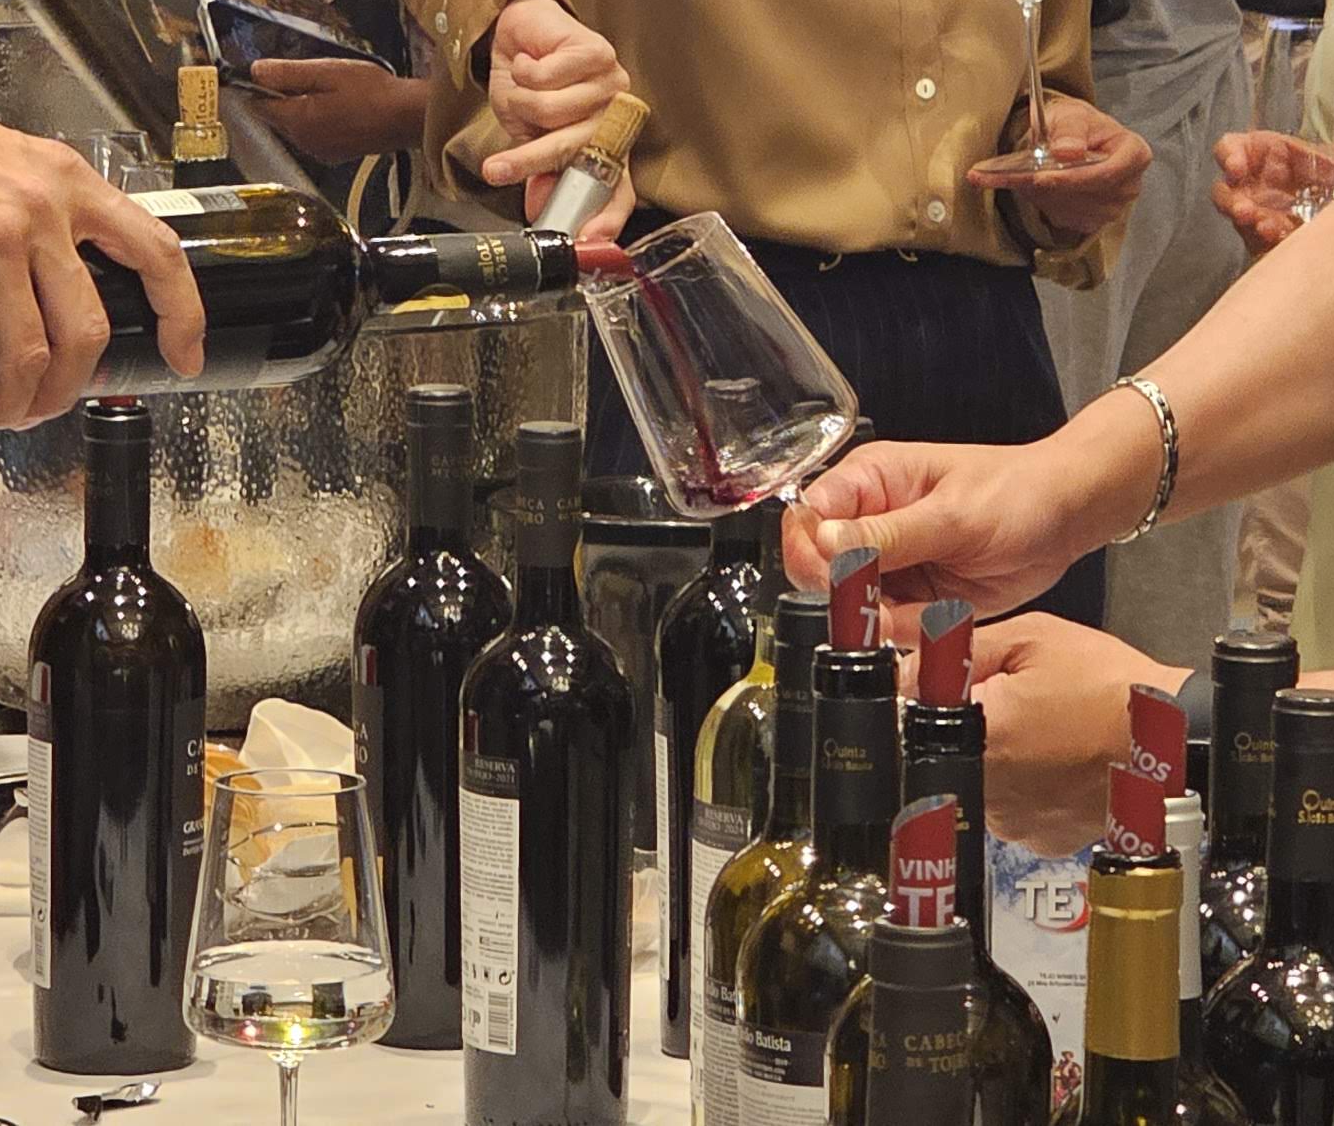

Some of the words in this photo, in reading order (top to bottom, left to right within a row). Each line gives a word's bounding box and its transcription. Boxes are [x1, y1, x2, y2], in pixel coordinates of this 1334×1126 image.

[898, 858, 956, 881] VINH
[897, 884, 956, 927] TE
[1015, 881, 1073, 920] TE
[755, 1030, 792, 1052] Batista
